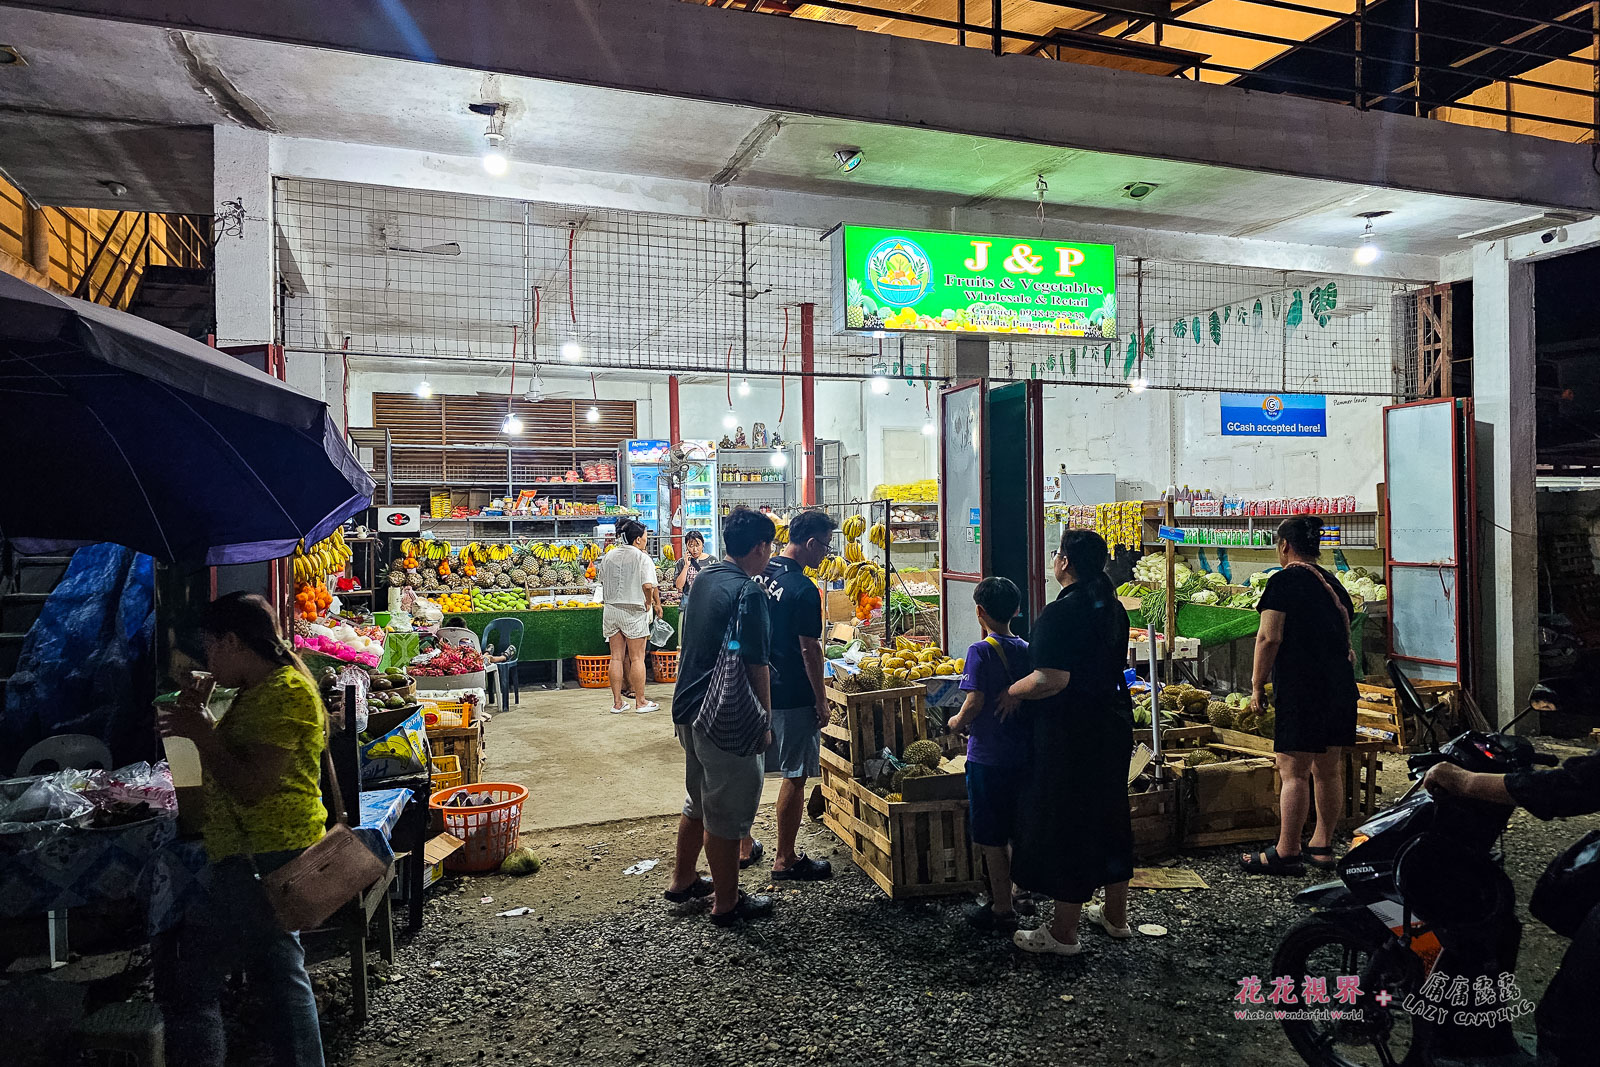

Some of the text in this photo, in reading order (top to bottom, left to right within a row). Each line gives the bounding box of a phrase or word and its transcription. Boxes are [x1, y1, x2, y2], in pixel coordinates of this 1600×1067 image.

[964, 240, 1085, 278] J & P
[944, 273, 1104, 295] Fruits & Vegetables
[963, 290, 1089, 307] Wholesale & Retail
[1226, 422, 1321, 434] GCash accepted here!
[1346, 866, 1375, 875] HONDA
